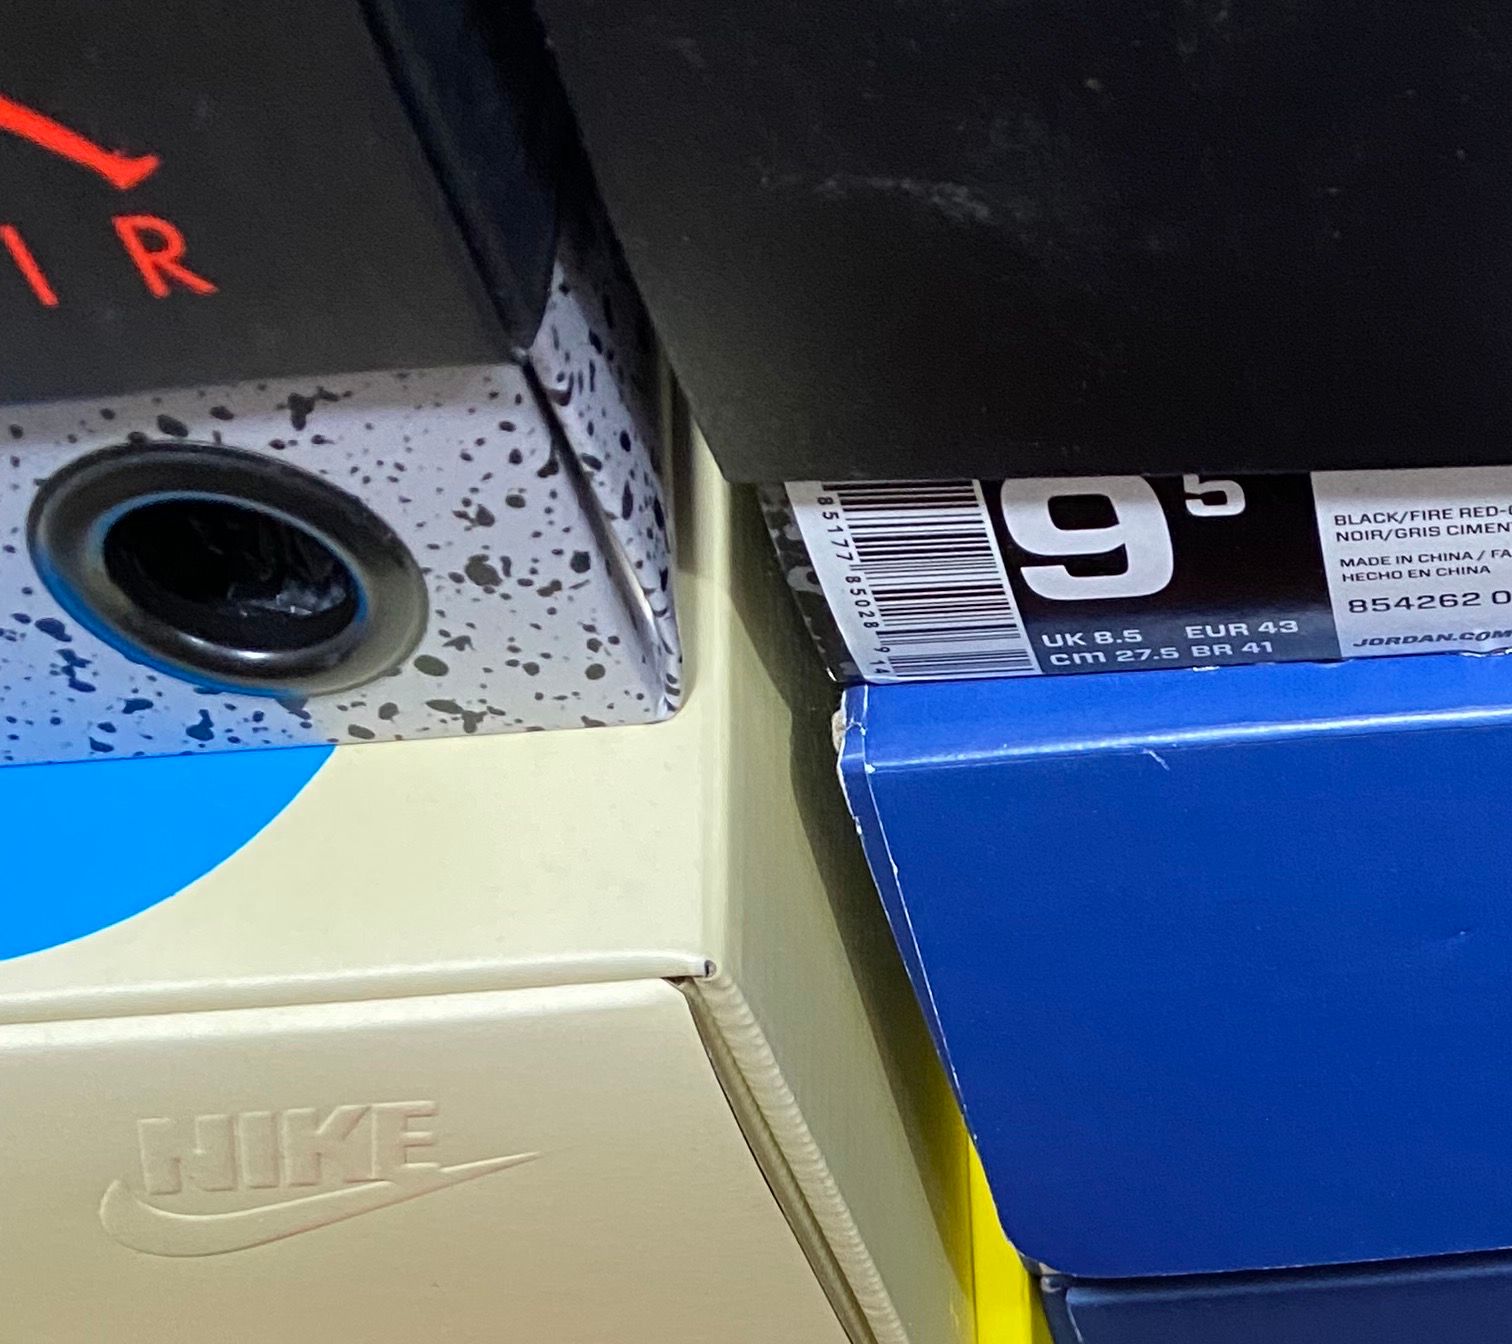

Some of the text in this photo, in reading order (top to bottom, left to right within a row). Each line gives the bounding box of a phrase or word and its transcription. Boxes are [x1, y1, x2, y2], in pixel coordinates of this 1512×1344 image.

[1334, 508, 1453, 526] BLACK/FIRE
[1000, 476, 1174, 601] 9
[1336, 526, 1441, 542] NOIR/GRIS
[1340, 555, 1391, 568] MADE
[1396, 555, 1413, 564] IN
[1418, 551, 1473, 563] CHINA
[1342, 565, 1491, 583] HECHO EN CHINA
[1349, 592, 1481, 614] 854262
[1041, 620, 1299, 648] UK 8.5 EUR 43
[1115, 647, 1180, 663] 27.5
[1191, 644, 1233, 658] BR
[1241, 641, 1274, 653] 41
[136, 1100, 440, 1195] NIKE
